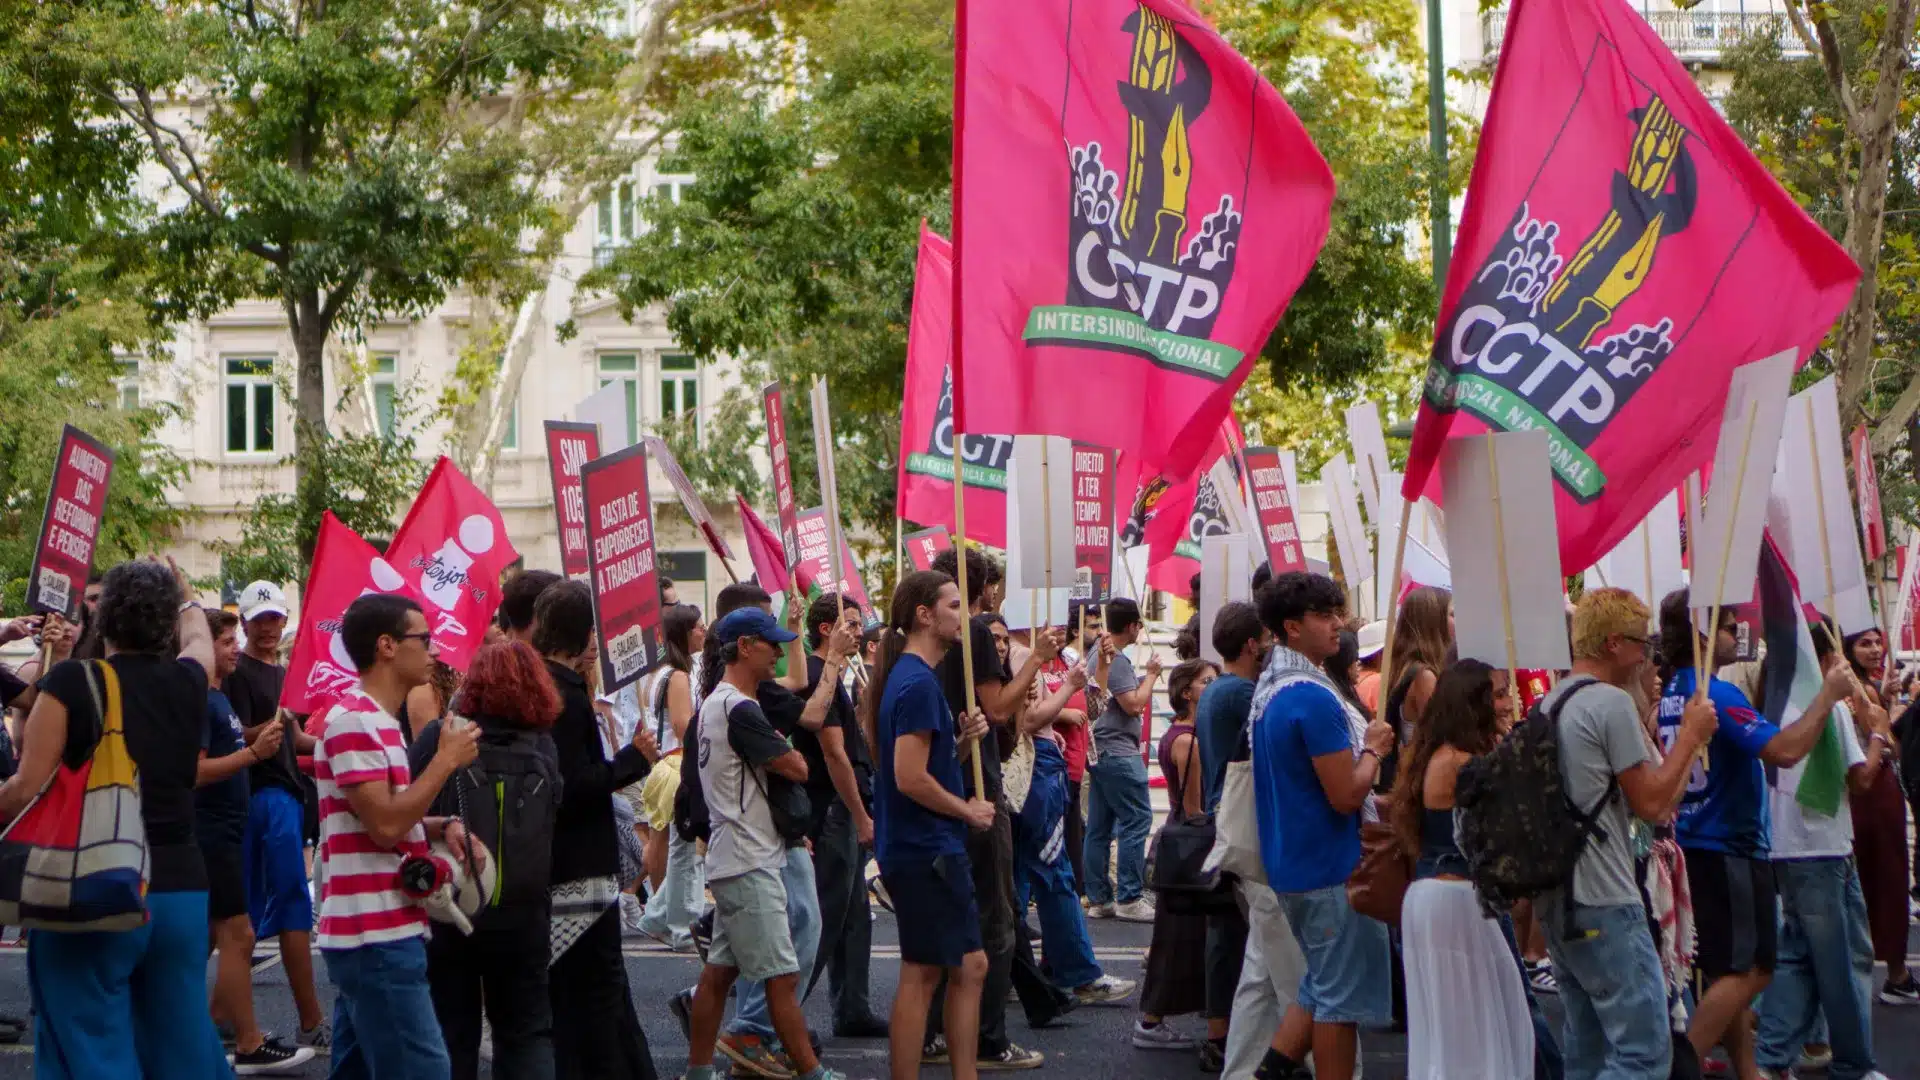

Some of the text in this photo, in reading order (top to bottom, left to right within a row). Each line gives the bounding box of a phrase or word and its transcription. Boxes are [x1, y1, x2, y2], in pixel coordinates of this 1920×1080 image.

[1075, 230, 1220, 333] CGTP
[1451, 304, 1615, 425] CGTP
[559, 438, 588, 477] SMN
[935, 416, 1014, 468] CGT
[68, 444, 108, 484] AUMENTO
[1075, 451, 1105, 473] DIREITO
[74, 477, 94, 505] DAS
[562, 486, 585, 524] 105
[1077, 476, 1100, 498] A TER
[54, 497, 97, 538] REFORMAS
[600, 491, 640, 530] BASTA DE
[1075, 500, 1101, 522] TEMPO
[47, 525, 91, 565] E PENSÕES
[595, 518, 650, 564] EMPOBRECER
[1075, 525, 1086, 547] RA
[1086, 525, 1110, 547] VIVER
[598, 548, 654, 596] A TRABALHAR
[257, 588, 271, 601] NY
[616, 633, 639, 657] SALÁRIO
[621, 650, 645, 674] DIREITOS
